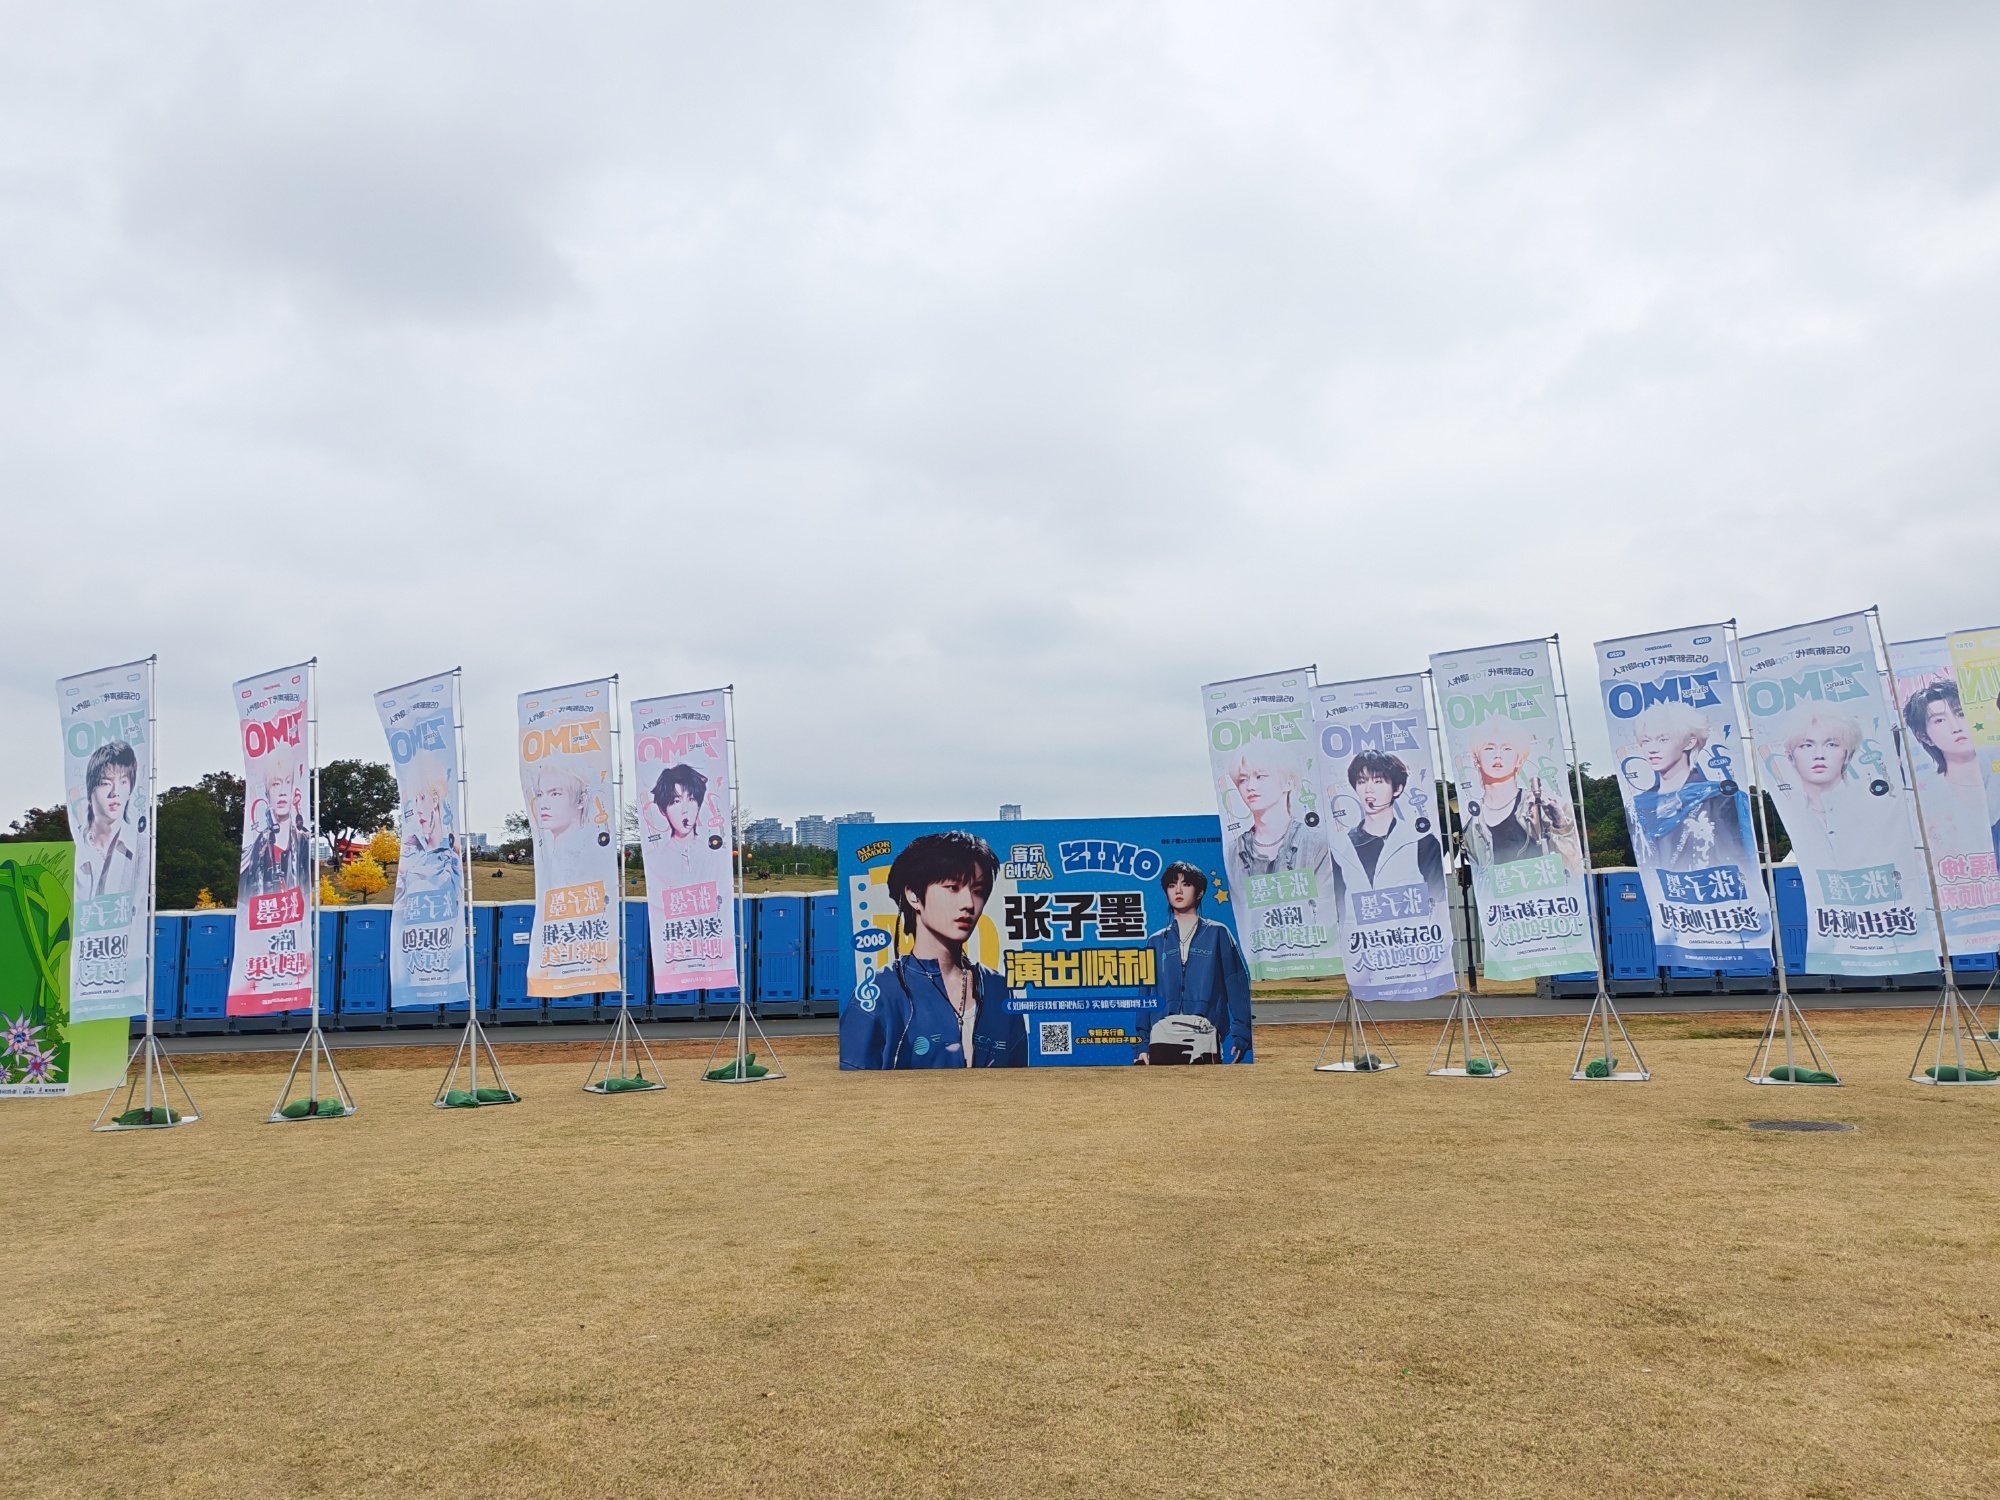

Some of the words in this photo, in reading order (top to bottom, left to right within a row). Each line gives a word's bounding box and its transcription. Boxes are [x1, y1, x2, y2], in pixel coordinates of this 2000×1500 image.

[873, 841, 890, 850] FOR
[859, 848, 891, 863] ZIMOOO
[1012, 845, 1044, 863] 音乐
[1059, 839, 1162, 881] ZIMO
[1005, 863, 1053, 879] 创作人
[1005, 893, 1146, 940] 张子墨
[855, 933, 886, 949] 2008
[1005, 949, 1156, 988] 演出顺利
[1088, 1029, 1125, 1037] 专辑先行曲
